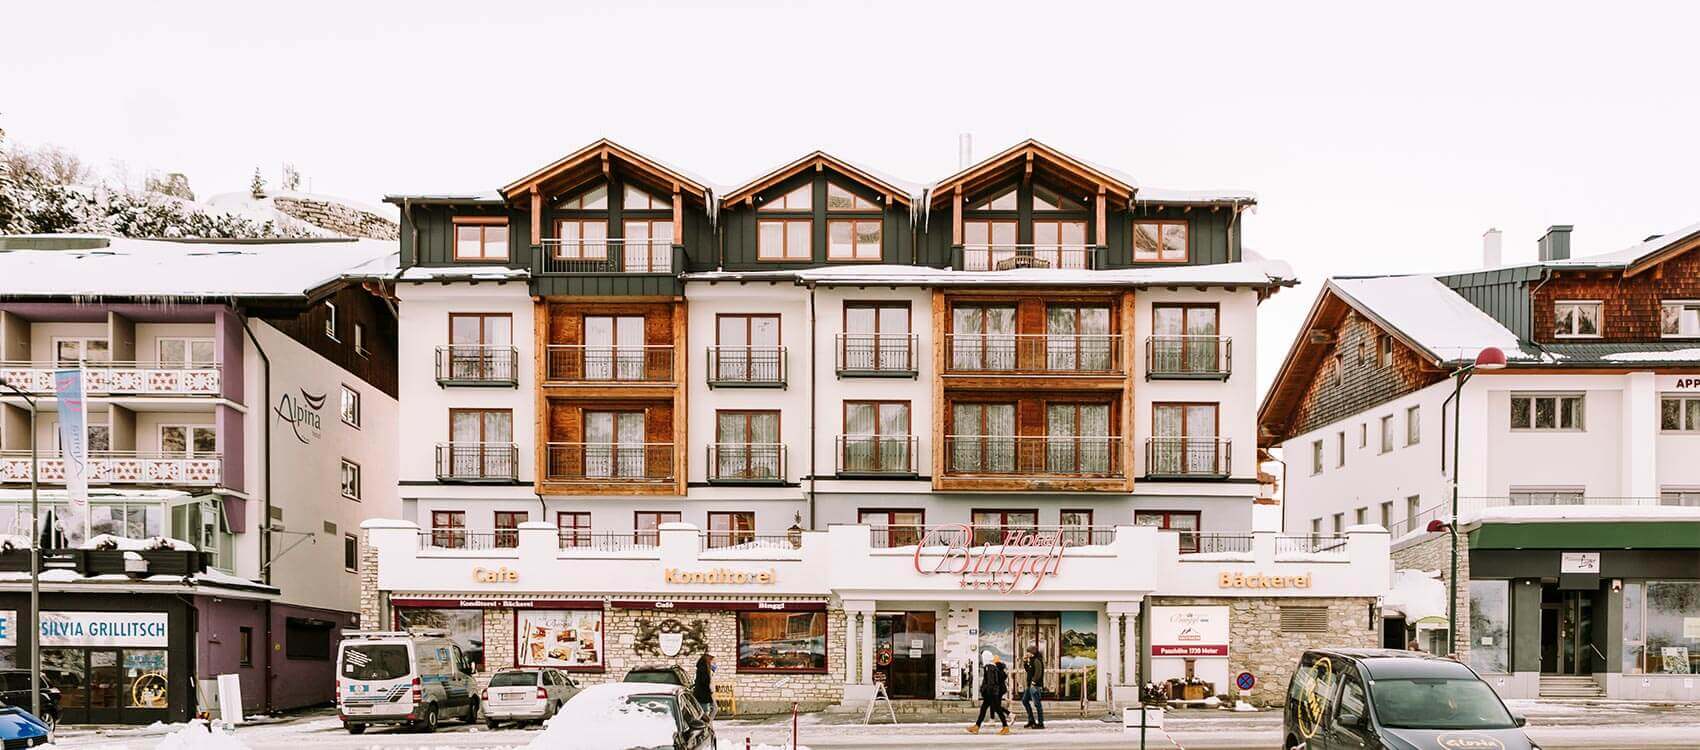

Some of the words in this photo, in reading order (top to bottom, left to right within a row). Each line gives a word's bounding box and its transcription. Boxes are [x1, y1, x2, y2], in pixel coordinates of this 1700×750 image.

[274, 394, 320, 444] Alpina
[1001, 528, 1063, 553] Hotel
[914, 524, 1073, 595] Binggl
[473, 566, 519, 583] Cafe
[665, 567, 776, 585] Konditorei
[1219, 570, 1312, 588] Bäckerei
[41, 622, 84, 636] SILVIA
[89, 622, 165, 636] GRILLITSCH
